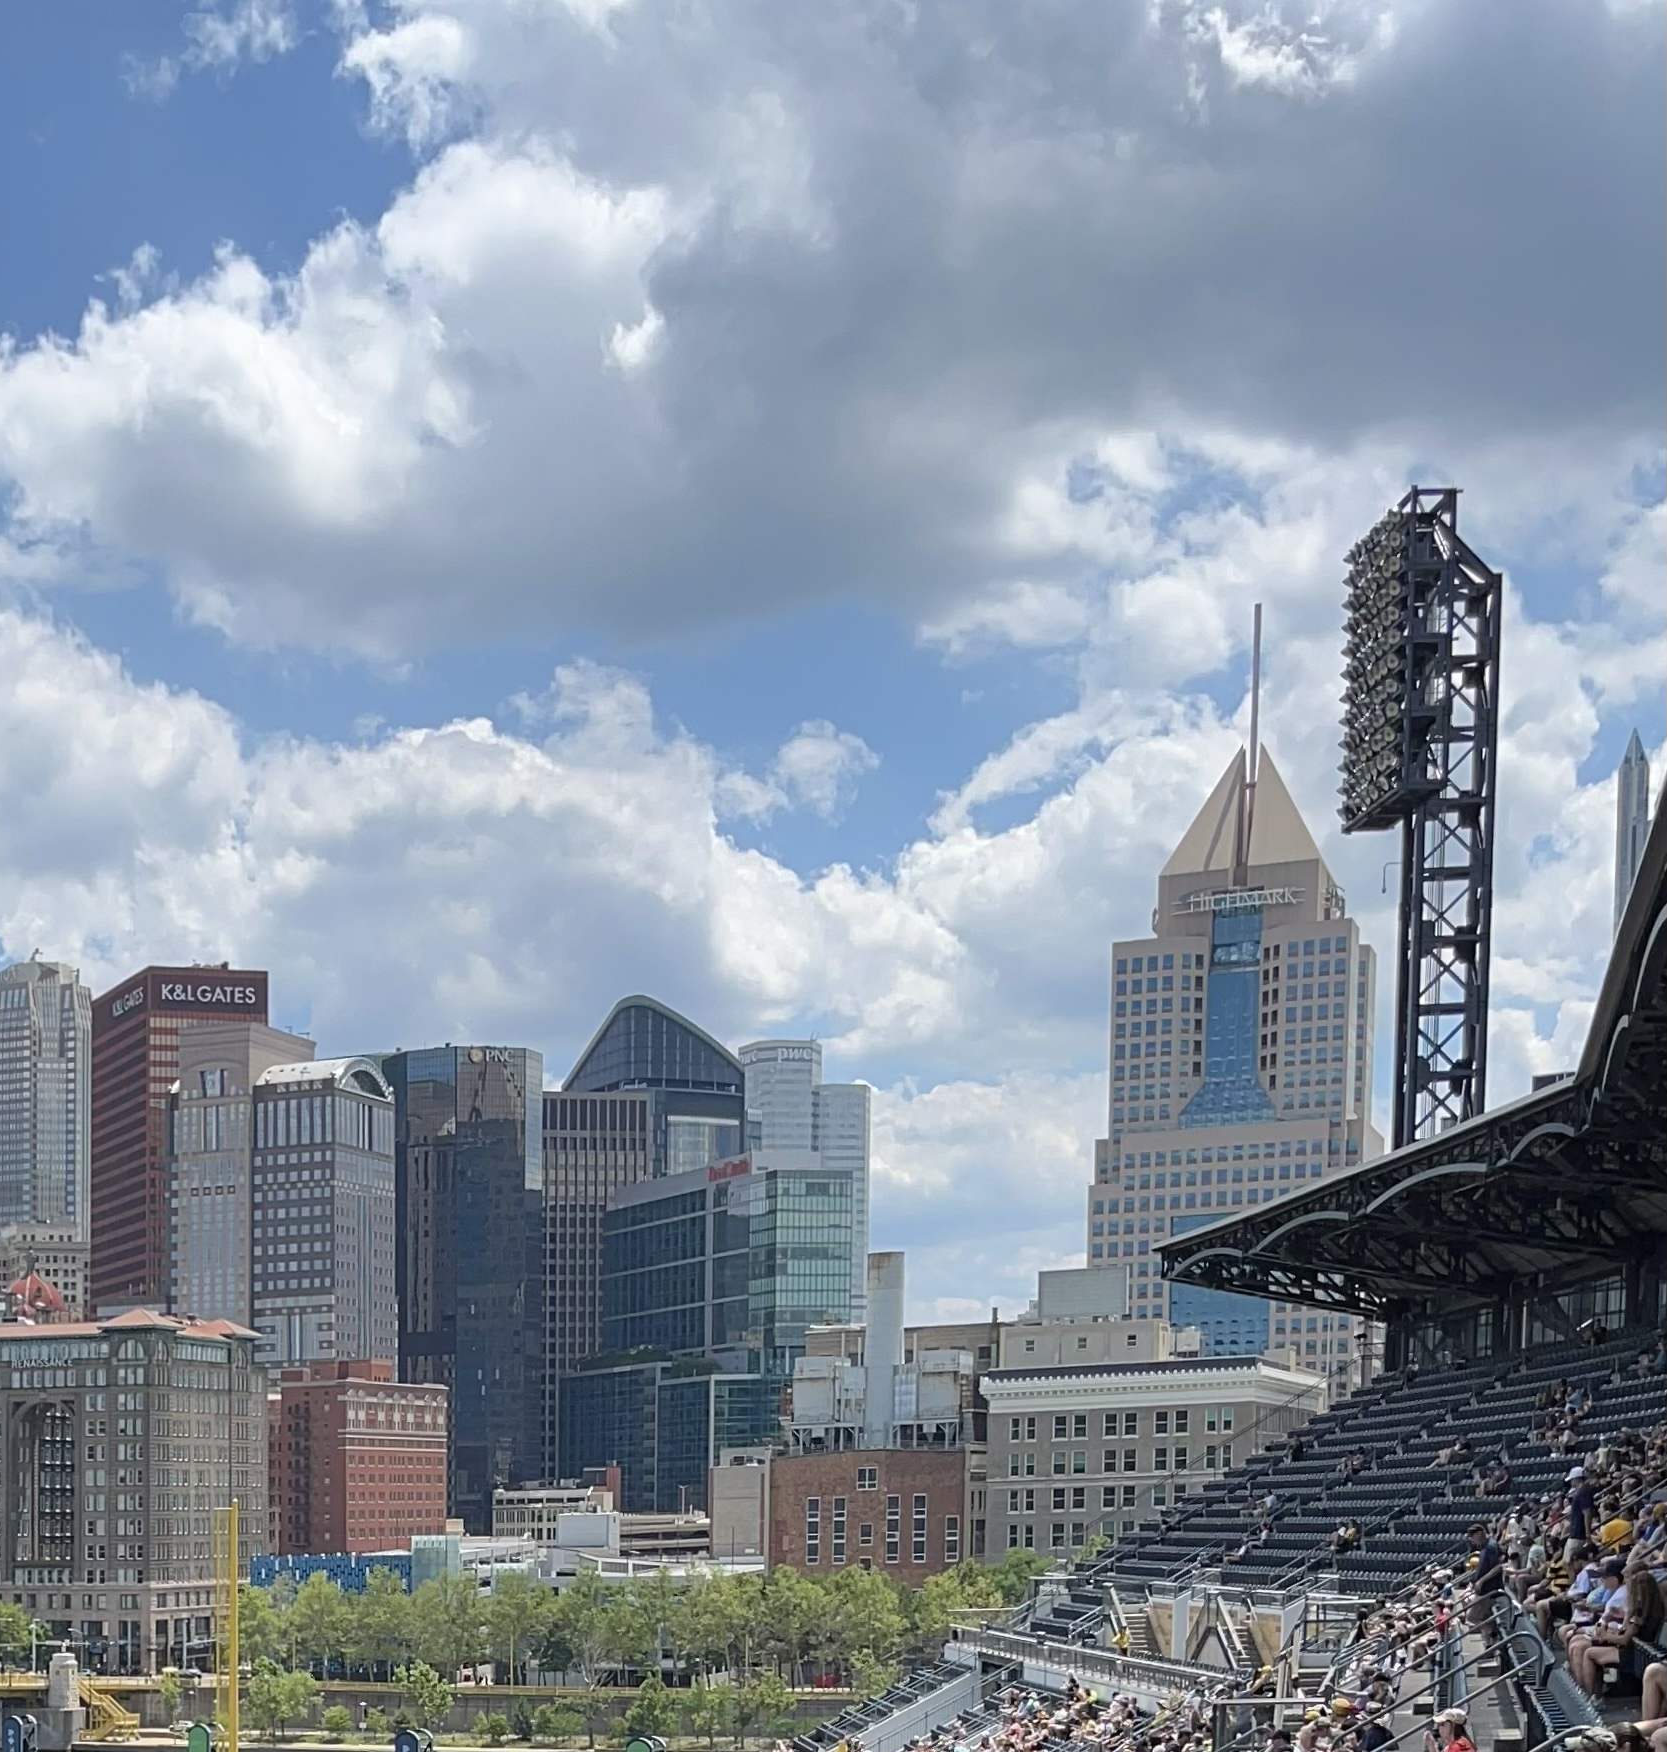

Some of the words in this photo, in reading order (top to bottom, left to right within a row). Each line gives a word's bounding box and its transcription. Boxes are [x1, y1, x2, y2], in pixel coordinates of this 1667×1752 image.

[161, 984, 194, 1000] K&L
[196, 985, 256, 1004] GATES
[485, 1050, 514, 1062] PNC
[777, 1047, 812, 1062] pwc
[12, 1359, 73, 1369] RENAISSANCE
